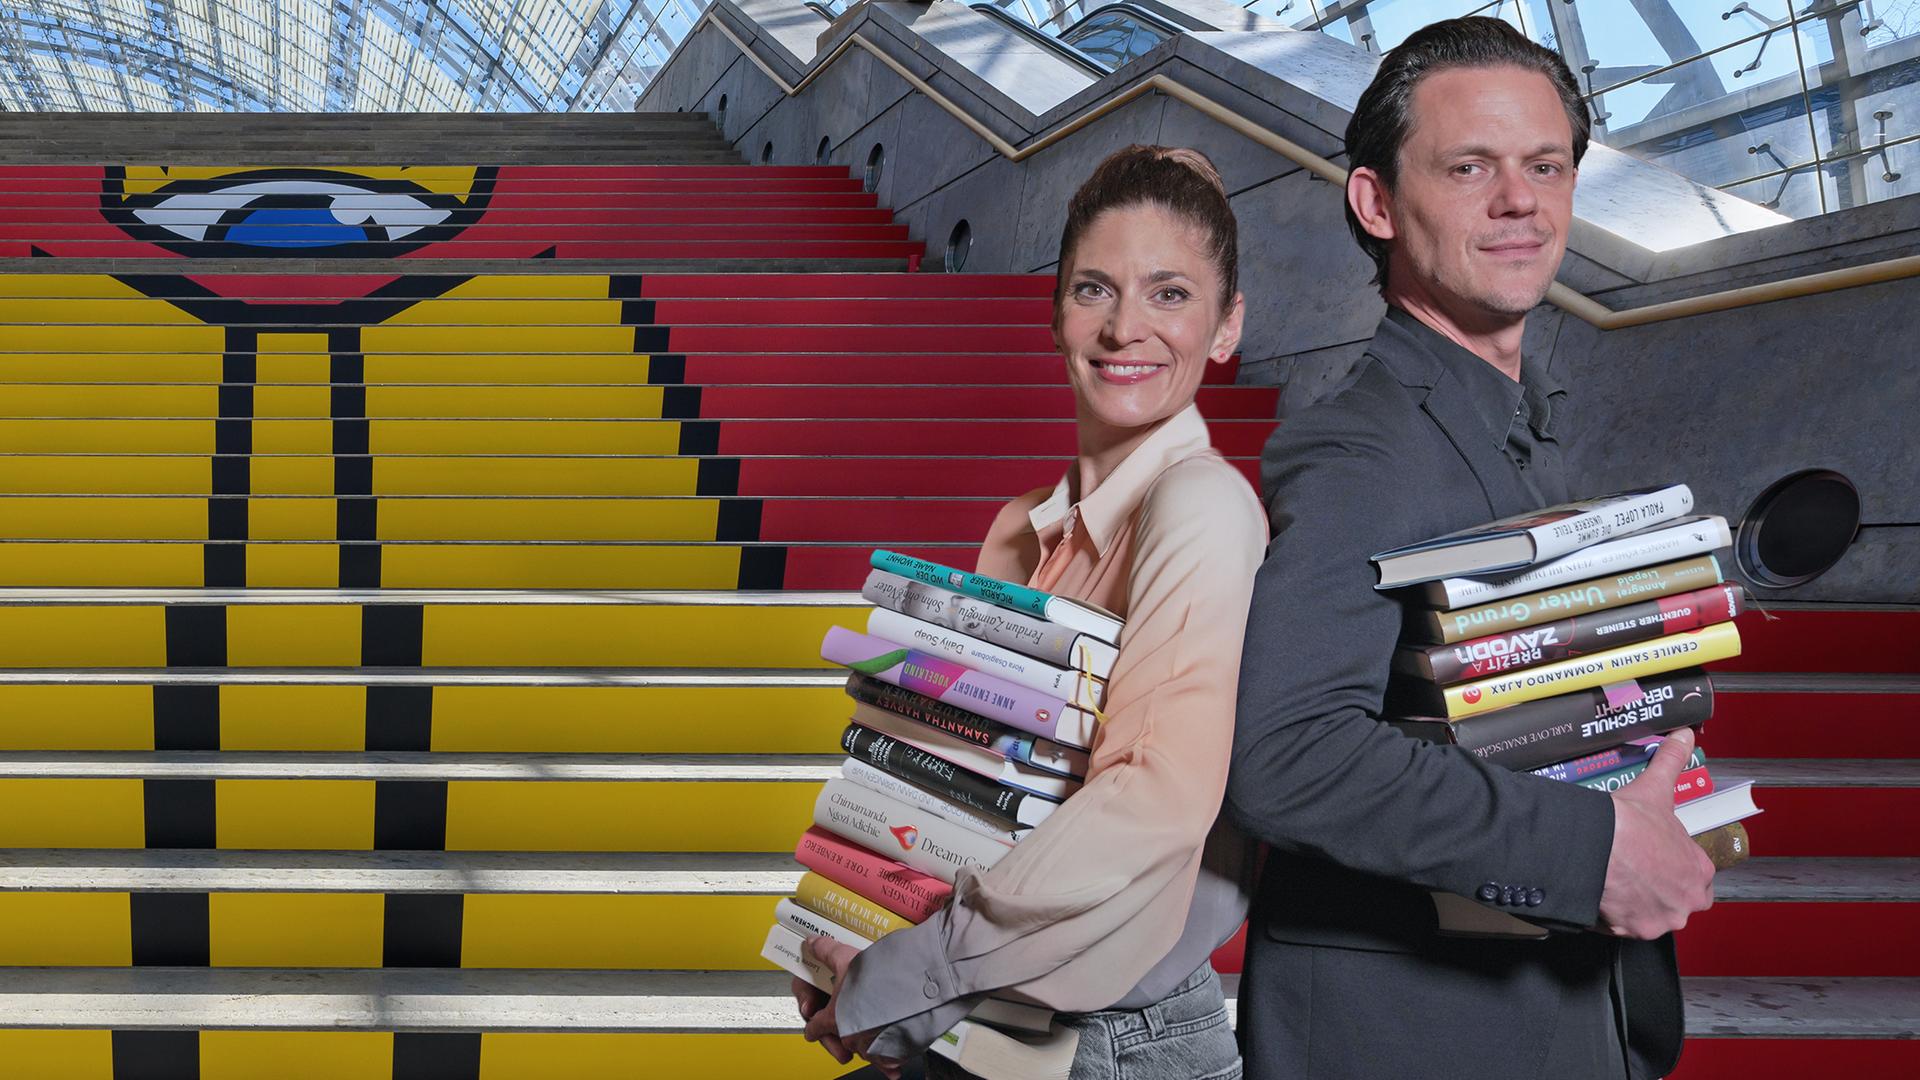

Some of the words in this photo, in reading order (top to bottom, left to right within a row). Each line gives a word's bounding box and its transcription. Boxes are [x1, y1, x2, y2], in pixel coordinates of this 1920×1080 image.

[1615, 508, 1640, 527] LOPEZ
[1641, 500, 1664, 519] PAOLA
[1555, 523, 1573, 539] TEILE
[1573, 515, 1604, 533] UNSERER
[1600, 524, 1612, 536] DIE
[1577, 528, 1600, 544] SUMME
[886, 554, 913, 567] WOHNT
[913, 561, 936, 573] NAME
[915, 570, 930, 582] DER
[931, 575, 945, 585] WO
[970, 576, 1006, 591] MESSNER
[1616, 570, 1660, 586] Liepold
[874, 582, 898, 600] Vater
[899, 587, 917, 603] ohne
[980, 588, 1014, 605] RICARDA
[1539, 586, 1607, 611] Unter
[1616, 581, 1668, 599] Annegret
[921, 595, 945, 613] Sohn
[958, 606, 1004, 633] Zaimoglu
[1455, 602, 1531, 636] Grund
[1638, 608, 1692, 627] GUENTHER
[1005, 621, 1044, 646] Feridun
[1596, 619, 1637, 636] STEINER
[914, 629, 939, 646] Soap
[940, 637, 965, 655] Daily
[971, 650, 1008, 668] Osagiobare
[1487, 648, 1542, 671] PŘEŽÍT
[1653, 641, 1698, 660] CEMILE
[1008, 661, 1025, 673] Nora
[1472, 662, 1482, 673] A
[1612, 652, 1650, 668] SAHIN
[904, 663, 951, 688] VOGELKIND
[1526, 664, 1604, 687] KOMMANDO
[953, 680, 990, 703] ENRIGHT
[1490, 680, 1522, 695] AJAX
[1643, 685, 1674, 705] DER
[875, 697, 920, 720] HARVEY
[991, 693, 1016, 711] ANNE
[1639, 703, 1663, 721] DIE
[925, 713, 990, 745] SAMANTHA
[1552, 722, 1574, 737] KARL
[1581, 711, 1638, 738] SCHULE
[1530, 729, 1551, 742] OVE
[831, 792, 887, 824] Chimamanda
[827, 806, 849, 824] Ngozi
[849, 816, 881, 839] Adichie
[804, 839, 844, 865] RENBERG
[920, 837, 963, 866] Dream
[1733, 837, 1742, 852] dtv
[844, 859, 871, 878] TORE
[881, 885, 921, 912] LUNGEN
[790, 913, 820, 934] WUCHERN
